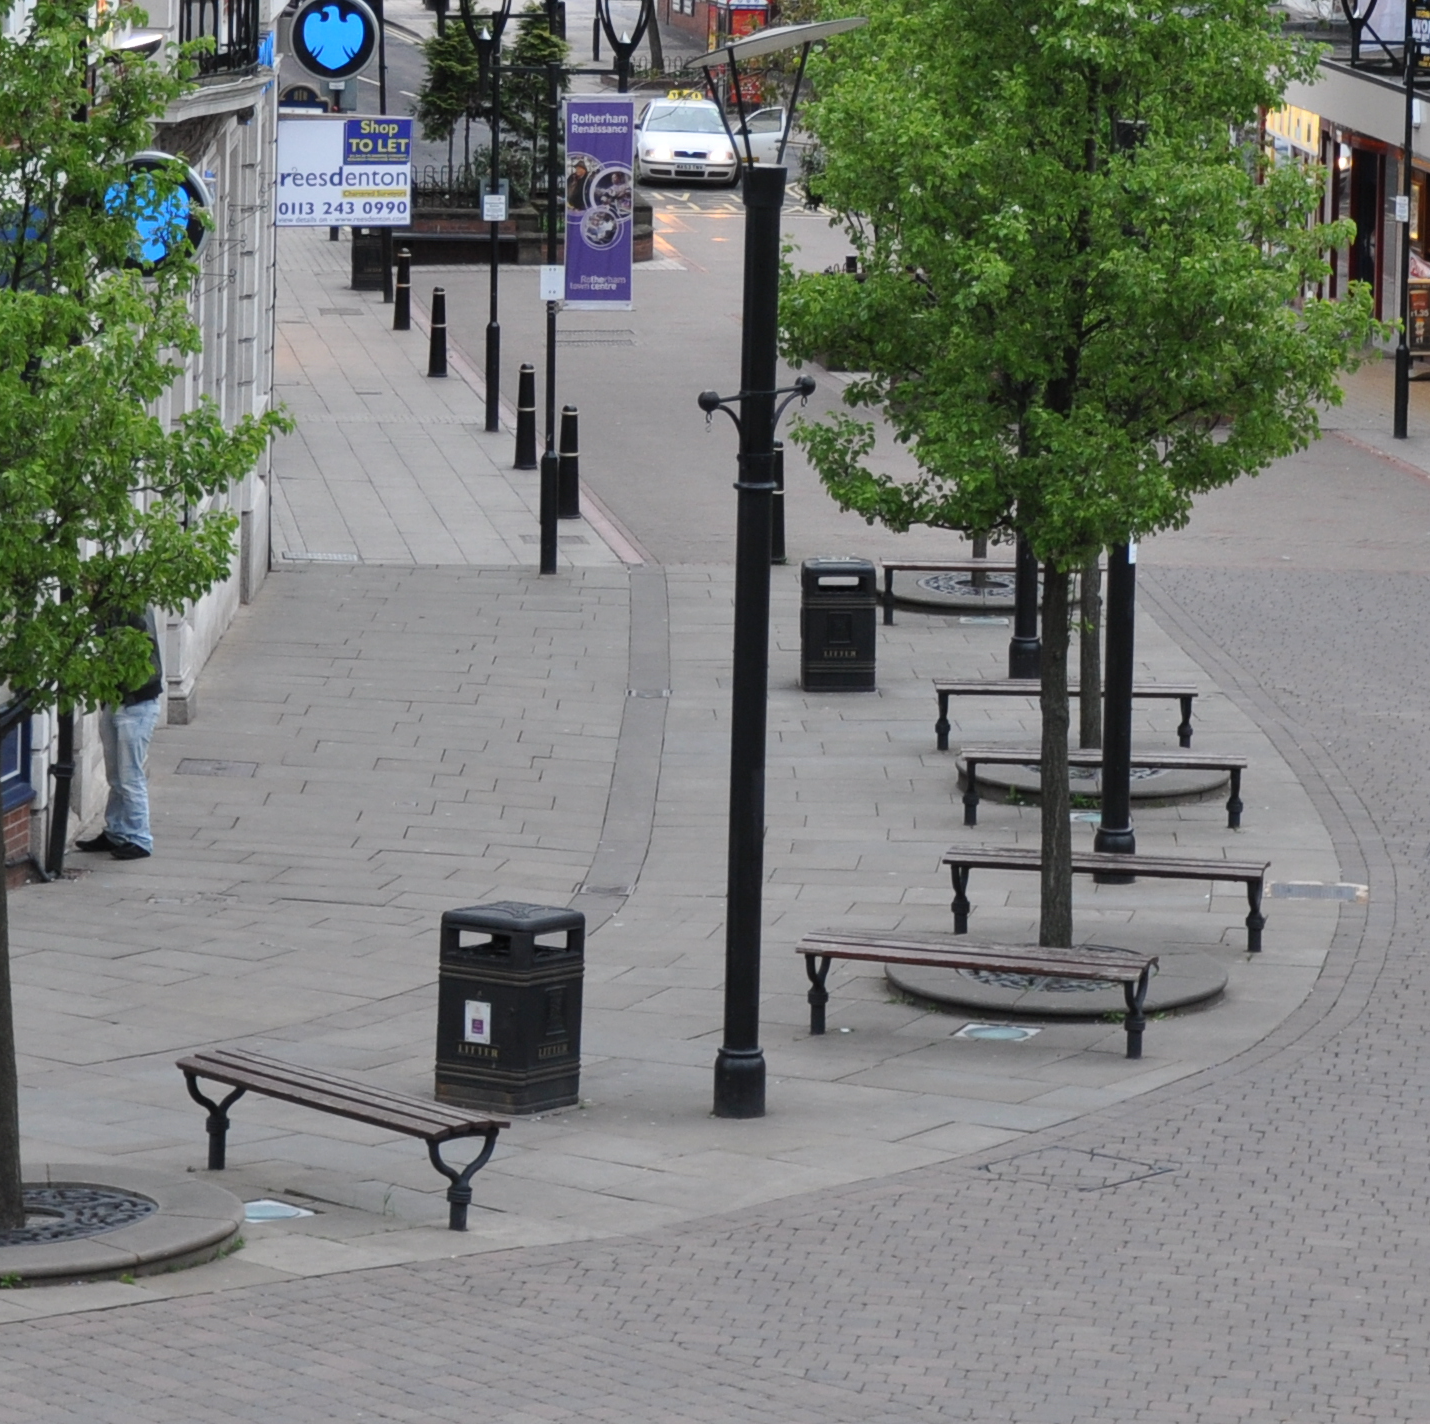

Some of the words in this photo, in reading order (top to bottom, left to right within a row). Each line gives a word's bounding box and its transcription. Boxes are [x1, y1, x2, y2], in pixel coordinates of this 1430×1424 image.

[571, 113, 629, 124] Rotherham
[360, 120, 399, 137] Shop
[571, 124, 628, 134] Renaissance
[349, 138, 373, 152] TO
[377, 138, 409, 152] LET
[280, 166, 407, 187] reesdenton
[278, 202, 314, 215] 0113
[322, 201, 355, 215] 243
[362, 201, 407, 215] 0990
[590, 282, 617, 290] centre
[458, 1043, 498, 1058] LITTER
[538, 1043, 568, 1059] LITTER
